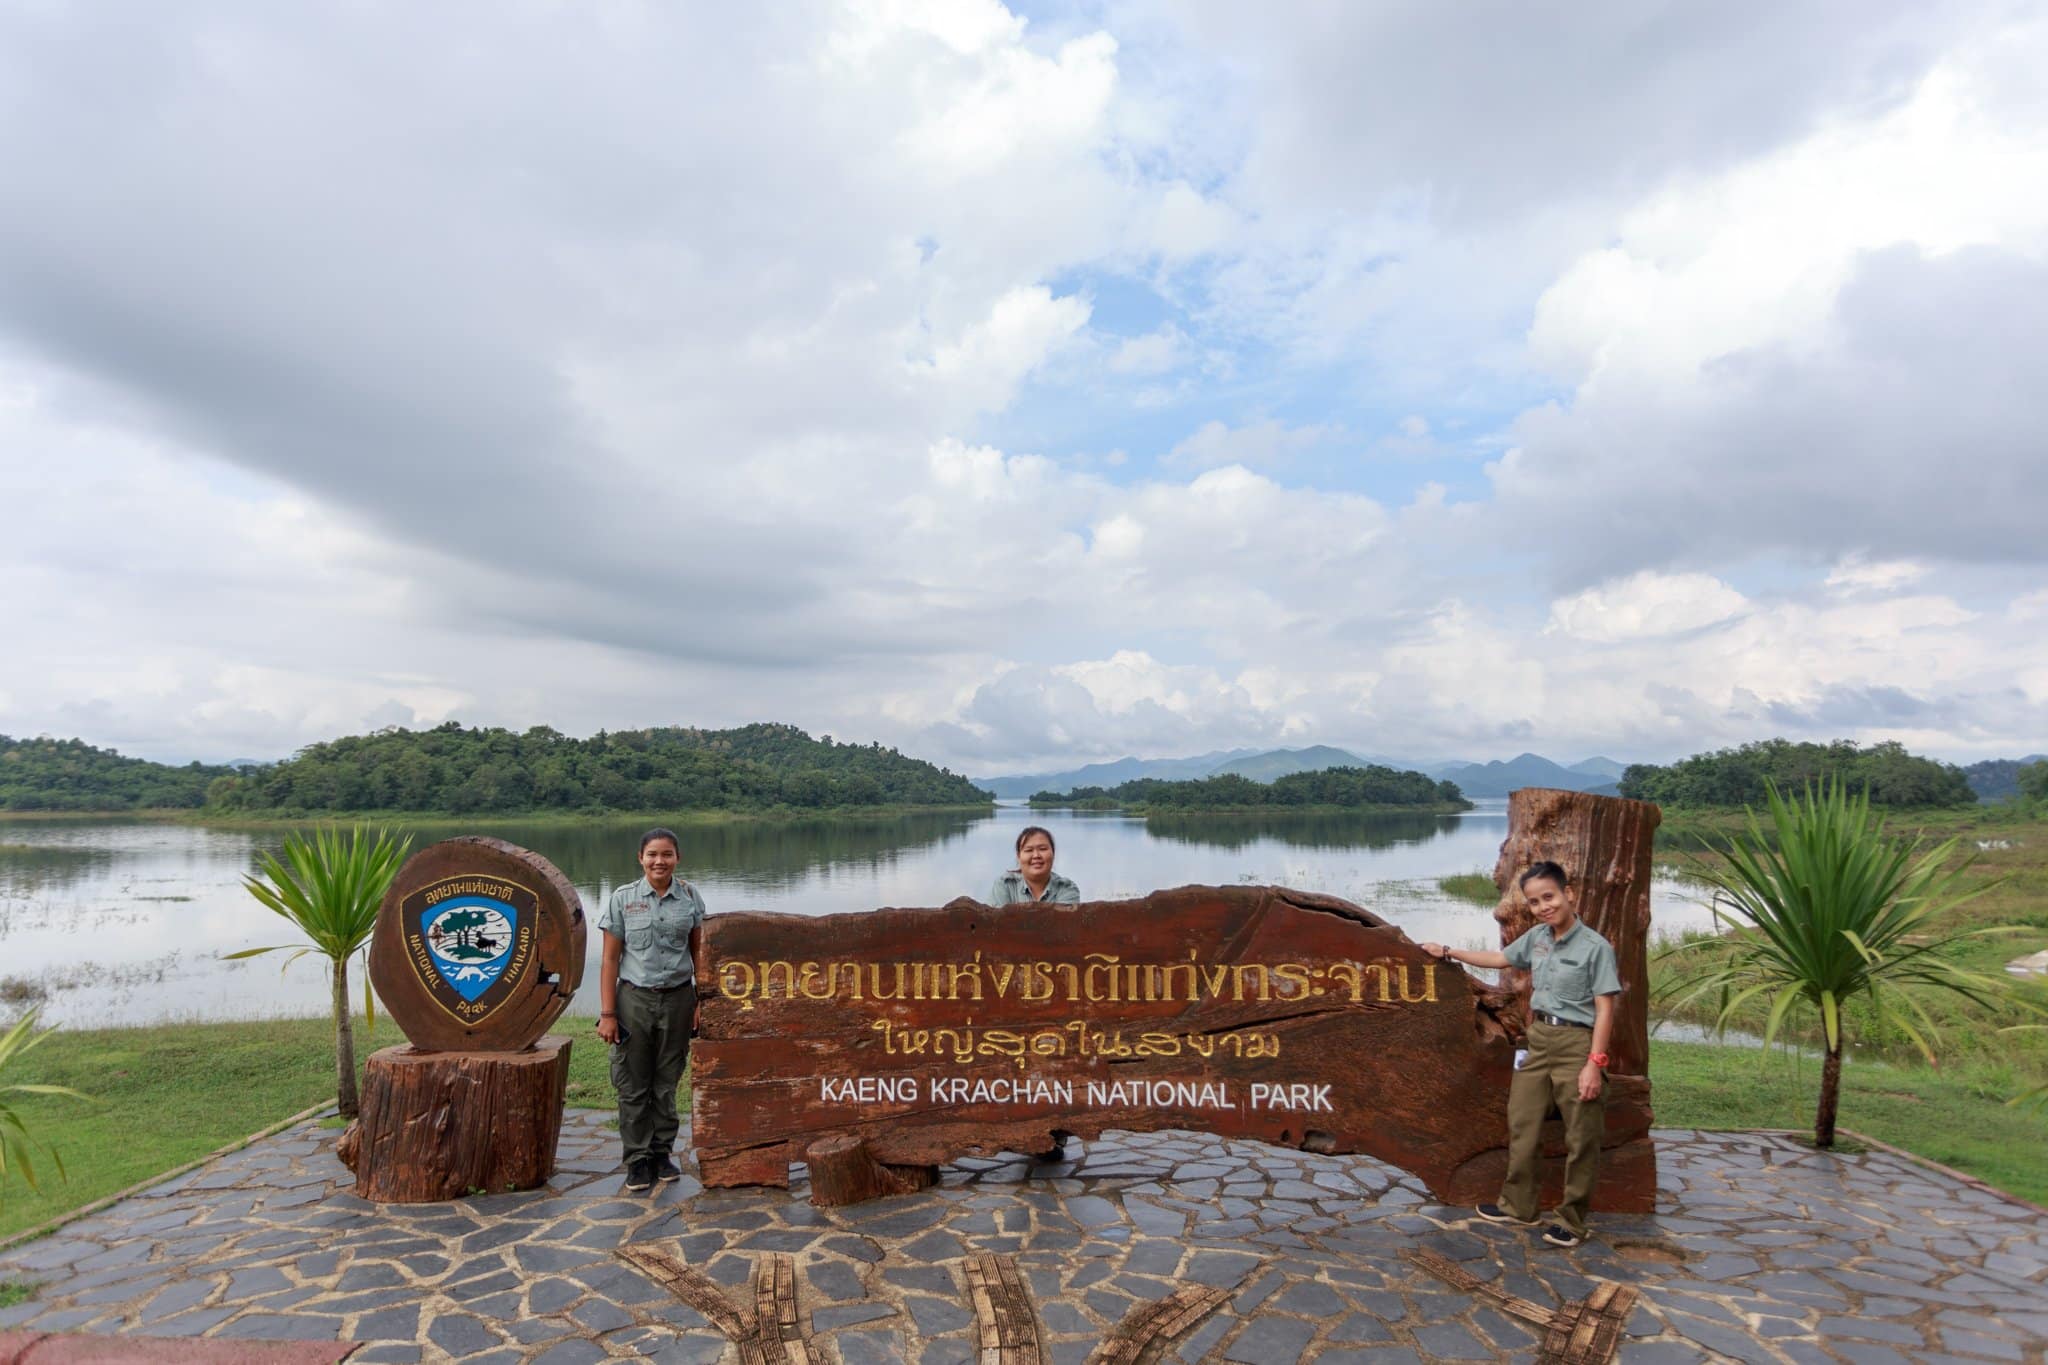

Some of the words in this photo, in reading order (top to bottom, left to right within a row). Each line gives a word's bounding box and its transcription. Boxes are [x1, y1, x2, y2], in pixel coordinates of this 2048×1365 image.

[425, 879, 514, 904] อุทยานแห่งชาติ
[409, 934, 440, 989] NATIONAL
[503, 927, 530, 983] THAILAND
[718, 948, 1439, 1011] อุทยานแห่งชาติแก่งกระจาน
[455, 1000, 488, 1017] PARK
[821, 1077, 918, 1103] KAENG
[930, 1077, 1073, 1105] KRACHAN
[1086, 1080, 1236, 1110] NATIONAL
[1249, 1083, 1334, 1112] PARK
